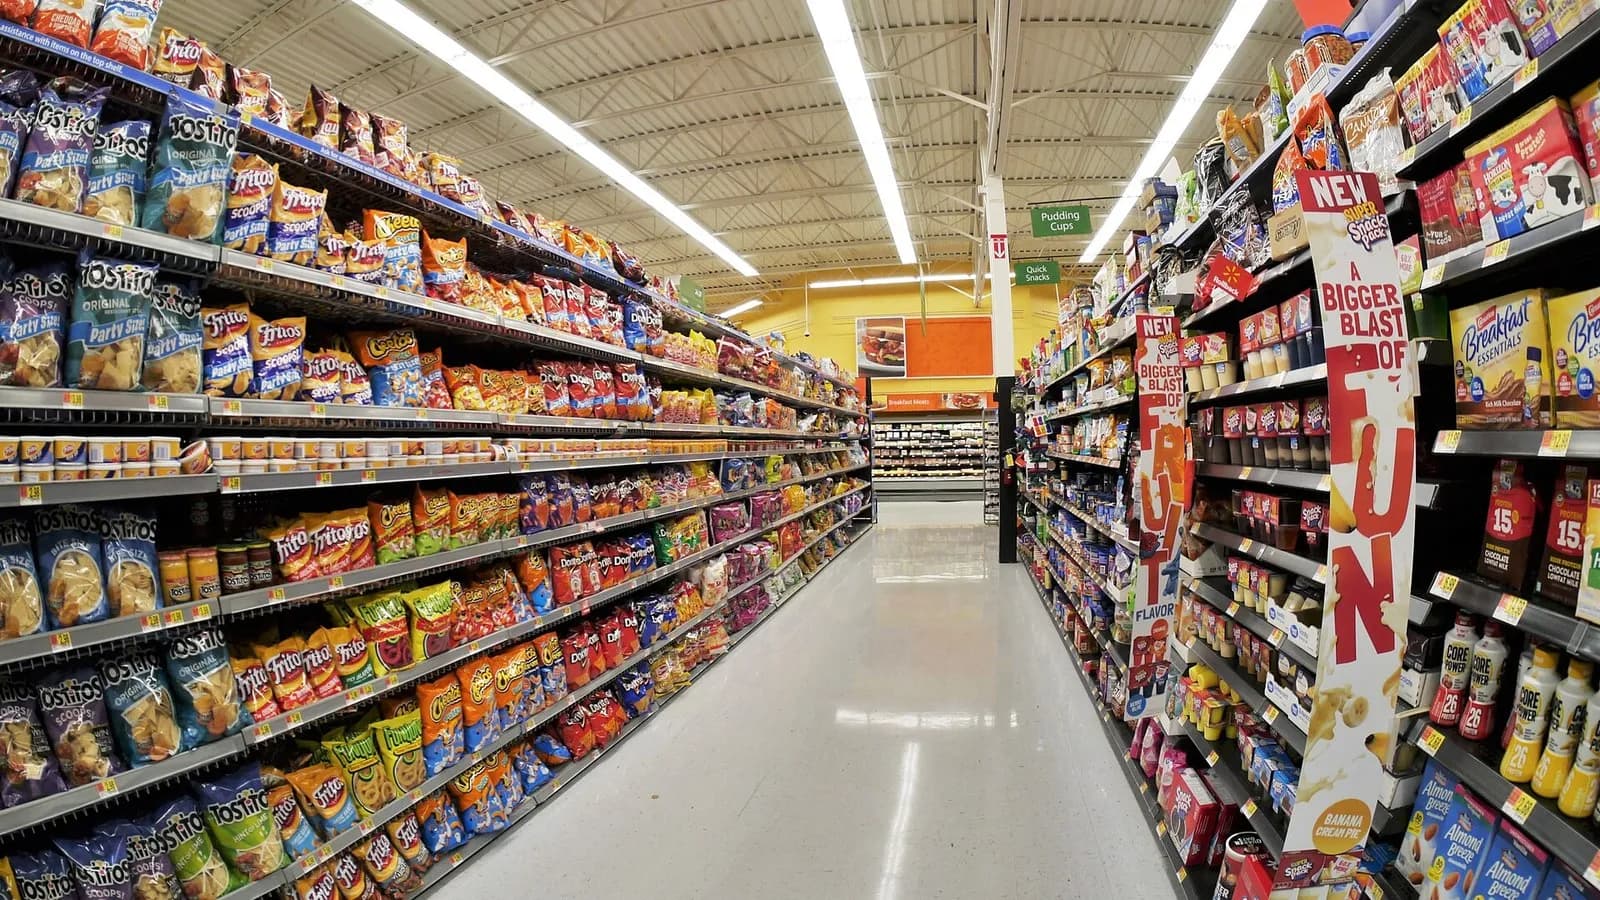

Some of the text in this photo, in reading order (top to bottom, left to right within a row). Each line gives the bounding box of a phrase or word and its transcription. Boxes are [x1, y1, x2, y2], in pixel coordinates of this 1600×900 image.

[0, 24, 34, 42] assistance
[34, 34, 51, 48] with
[50, 38, 70, 54] items
[69, 48, 80, 57] on
[80, 50, 93, 62] the
[92, 56, 105, 68] top
[166, 39, 201, 61] Frito
[169, 114, 238, 152] TOSTITO
[1520, 129, 1546, 160] Protein
[1483, 157, 1512, 185] HORIZON
[1309, 174, 1369, 209] NEW
[231, 201, 268, 221] SCOOPS!
[1041, 211, 1080, 224] Pudding
[1343, 201, 1378, 222] SUPER
[375, 214, 420, 241] Cheeto
[1050, 221, 1074, 233] Cups
[1347, 215, 1389, 243] Snack
[80, 260, 156, 298] TOSTITO
[1025, 273, 1050, 282] Snacks
[1026, 265, 1048, 276] Quick
[1350, 261, 1362, 282] A
[1213, 275, 1240, 297] Rollback
[1321, 283, 1400, 312] BIGGER
[19, 295, 57, 310] COOPS!
[82, 297, 131, 312] ORIGINAL
[90, 323, 124, 343] Party
[125, 317, 146, 334] Size!
[1143, 318, 1174, 337] NEW
[1341, 307, 1404, 338] BLAST
[1461, 296, 1533, 363] Breakfast
[1378, 340, 1409, 370] OF
[1477, 334, 1522, 367] ESSENTIALS
[1141, 364, 1180, 378] BIGGER
[1148, 377, 1183, 393] BLAST
[1167, 393, 1183, 407] OF
[1326, 343, 1415, 666] FUN
[100, 519, 157, 543] OSTITOS
[310, 523, 350, 557] Frito
[276, 529, 309, 565] Frito
[1484, 549, 1510, 563] CHOCOLATE
[1547, 563, 1581, 580] CHOCOLATE
[1547, 573, 1579, 588] LOWFAT MILK
[1135, 602, 1175, 622] FLAVOR
[170, 628, 224, 660] TOSTITO
[335, 638, 367, 664] Frito
[1446, 644, 1469, 661] CORE
[101, 648, 160, 688] TOSTITO
[265, 650, 302, 685] Frito
[1445, 660, 1466, 673] POWER
[40, 674, 103, 710] OSTITOS
[235, 668, 267, 702] Frito
[430, 682, 462, 723] Cheeto
[1443, 694, 1458, 713] 26
[1520, 686, 1540, 709] CORE
[1466, 707, 1482, 728] 26
[1511, 744, 1527, 768] 26
[312, 776, 345, 808] Frito
[1422, 780, 1454, 802] Almon
[208, 790, 268, 826] TOSTITO
[1425, 797, 1452, 816] Breeze
[1315, 826, 1362, 839] CREAM PIE
[1323, 813, 1363, 829] BANANA
[1443, 823, 1484, 851] Almond
[1447, 842, 1476, 865] Breeze
[132, 862, 164, 874] COOPS!
[1485, 861, 1532, 893] Almond
[17, 872, 75, 900] TOSTITO
[1488, 881, 1521, 900] Breeze
